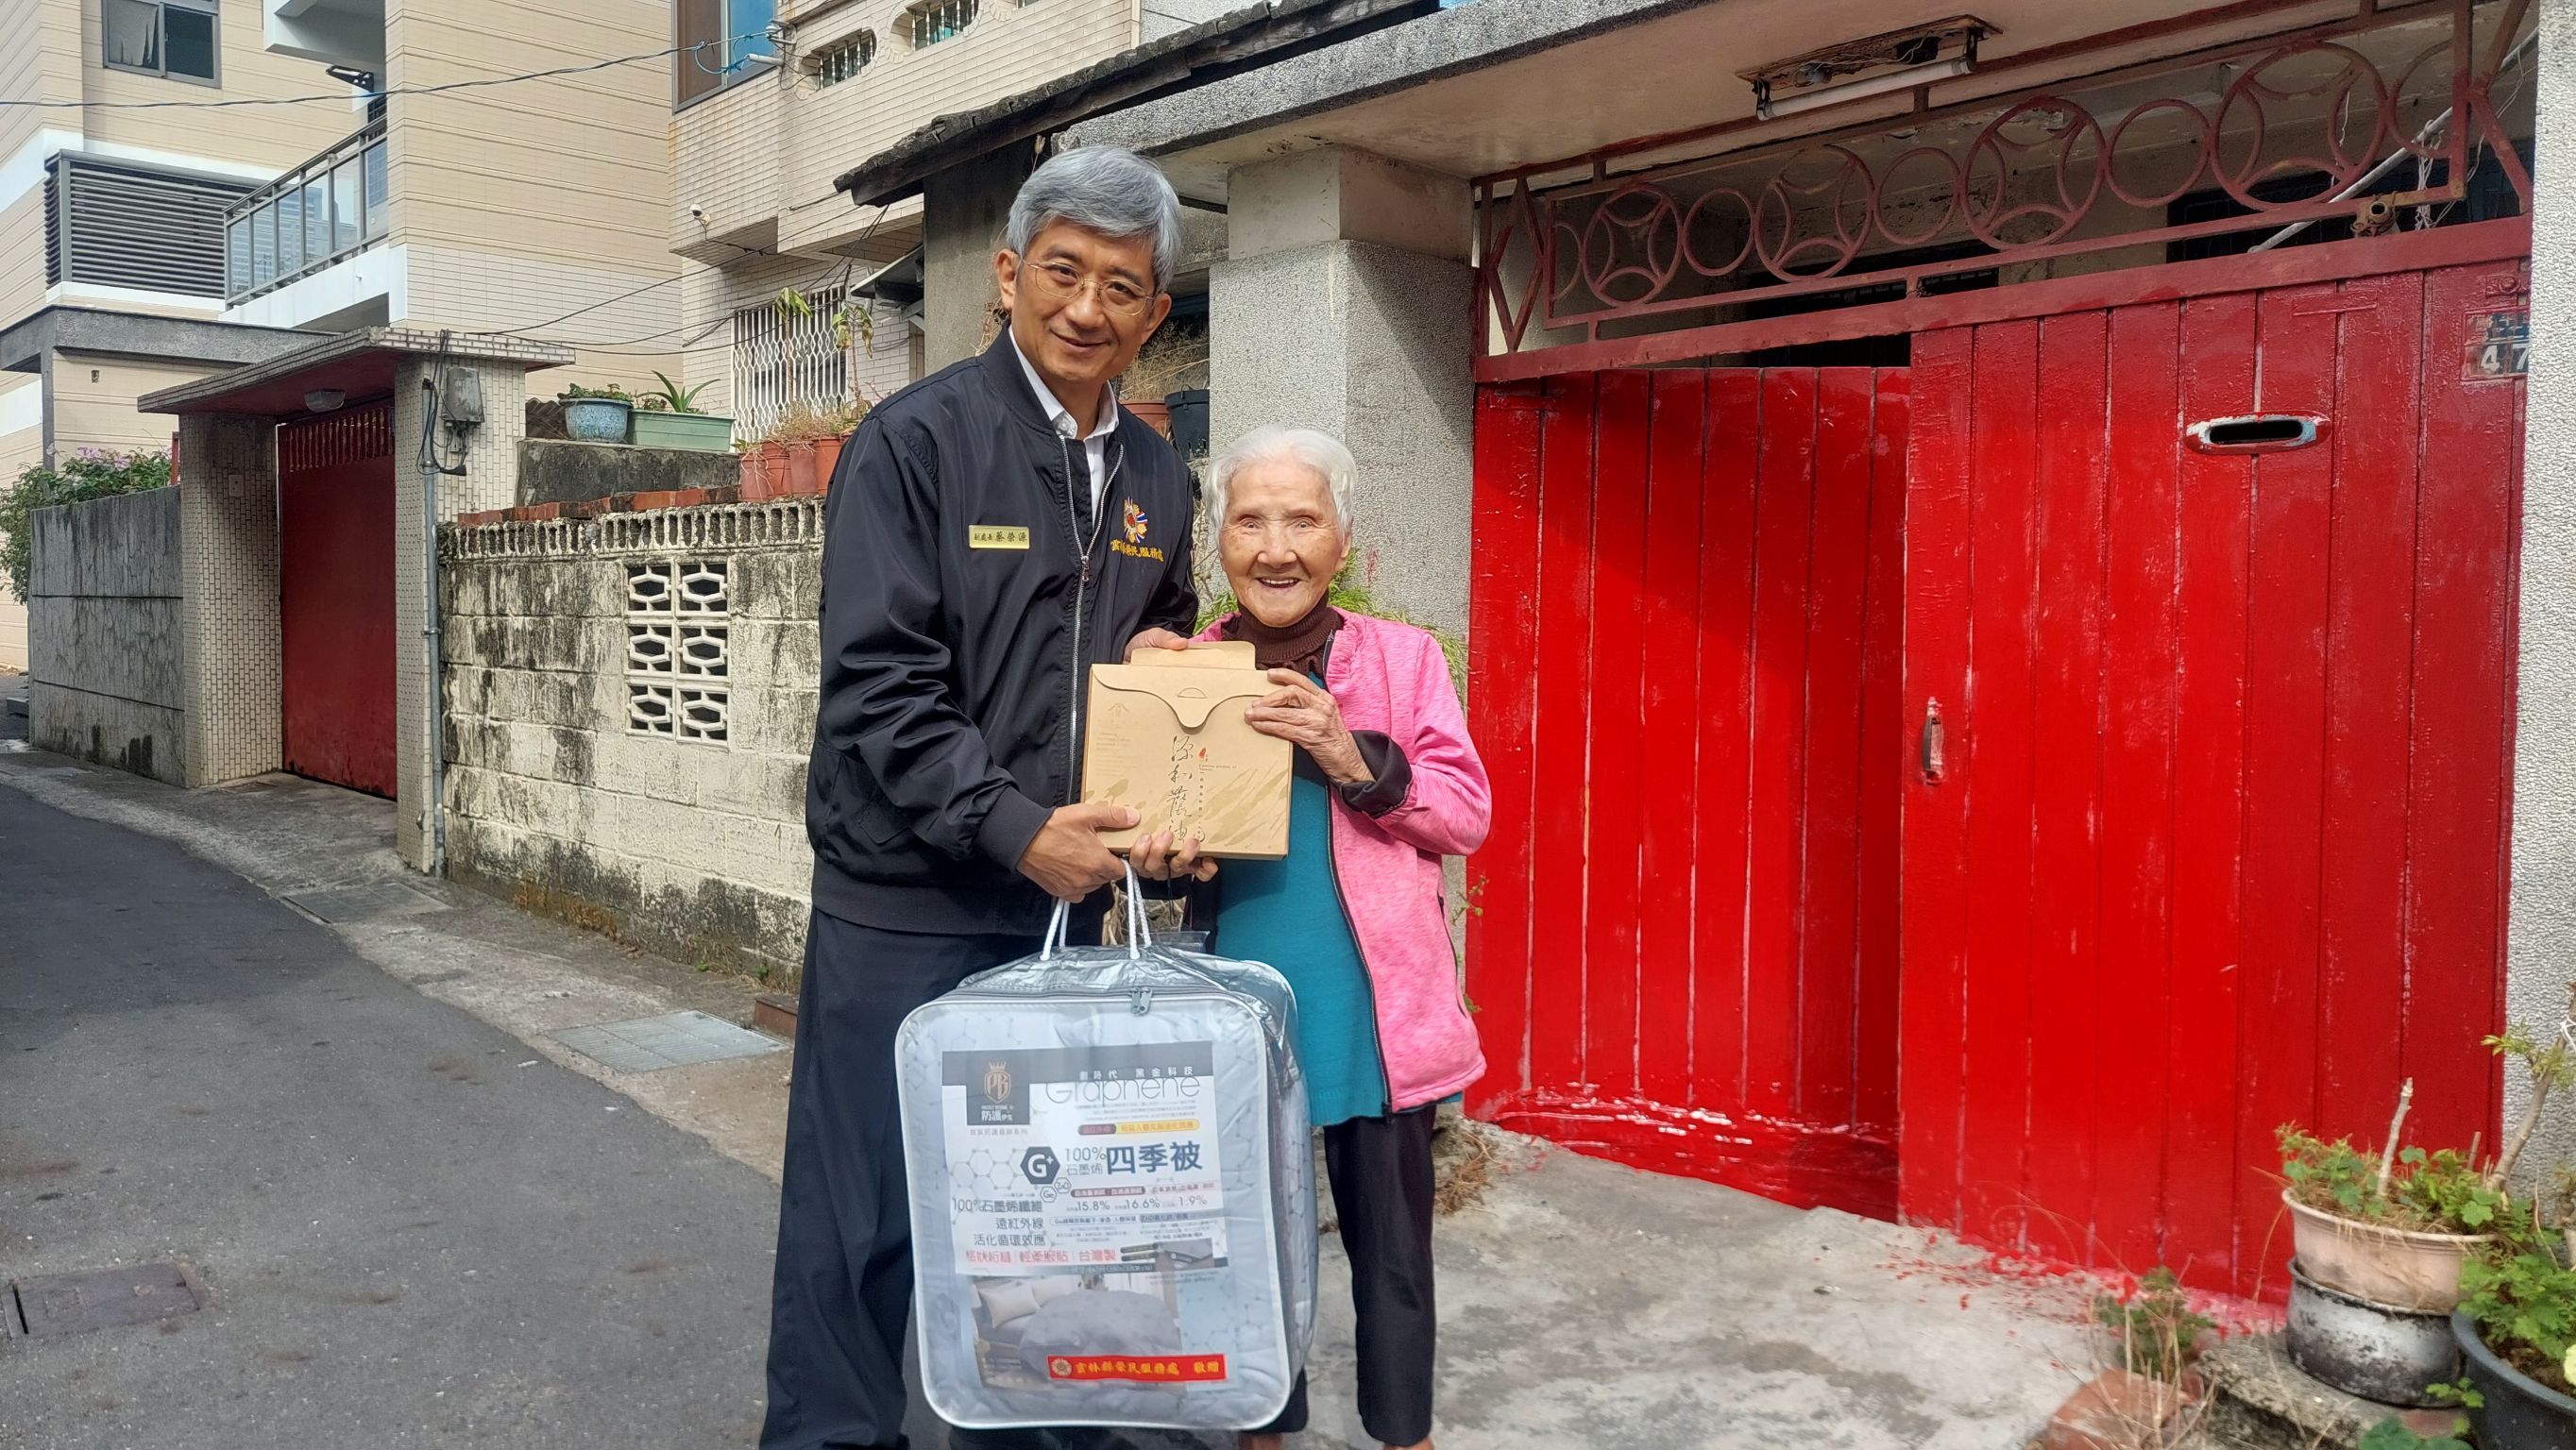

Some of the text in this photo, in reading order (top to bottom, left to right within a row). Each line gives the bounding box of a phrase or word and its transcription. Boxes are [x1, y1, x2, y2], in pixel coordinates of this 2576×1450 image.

[2481, 344, 2531, 373] 47
[1065, 1140, 1203, 1174] 100% 四季被
[1077, 1200, 1110, 1211] 15.8%
[1126, 1197, 1161, 1209] 16.6%
[1179, 1195, 1208, 1206] 1.9%
